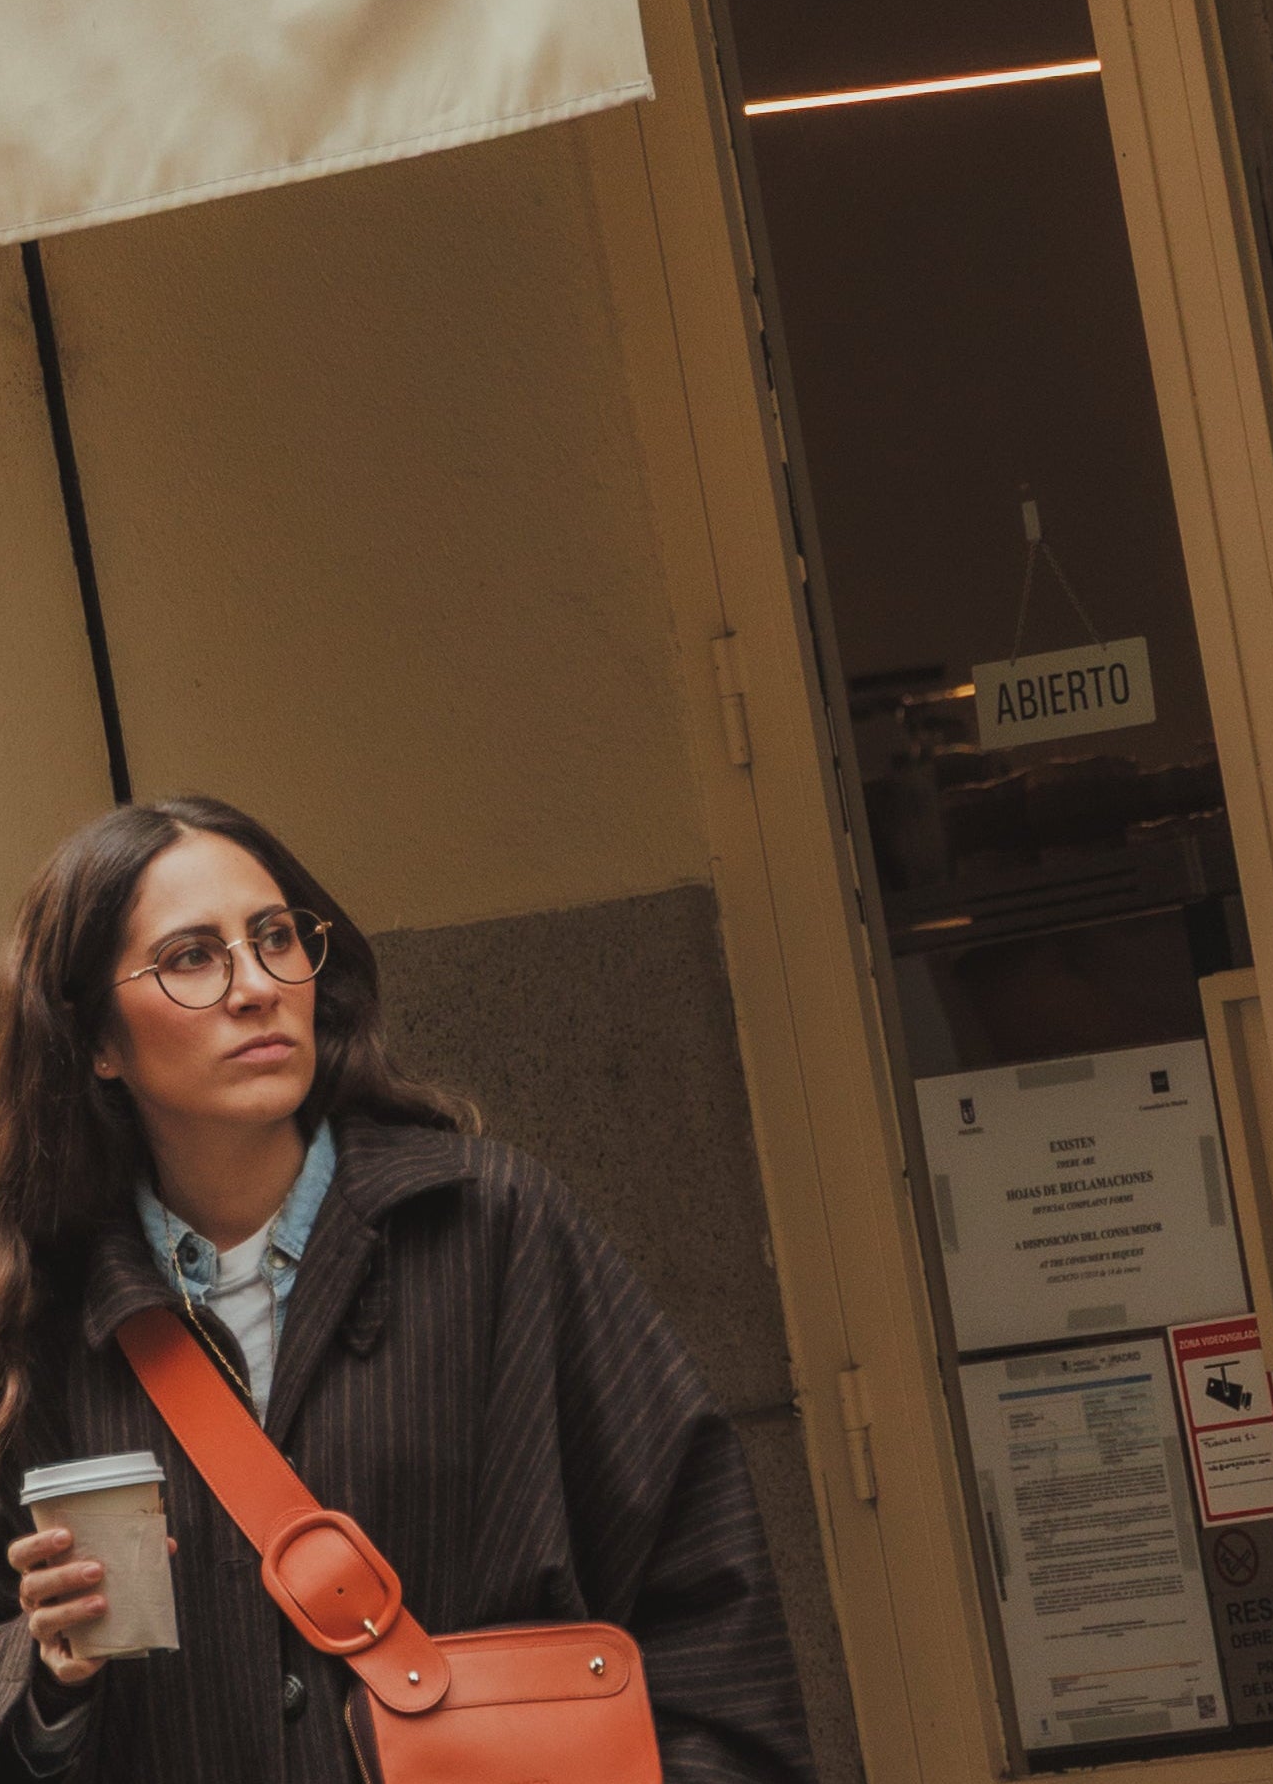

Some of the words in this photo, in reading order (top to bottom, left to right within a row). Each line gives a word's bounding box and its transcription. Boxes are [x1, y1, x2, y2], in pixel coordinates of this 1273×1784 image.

[997, 662, 1130, 725] ABIERTO
[1049, 1136, 1096, 1153] EXISTEN
[1006, 1186, 1042, 1202] HOJAS
[1043, 1183, 1059, 1197] DE
[1059, 1170, 1154, 1195] RECLAMACIONES
[1015, 1242, 1022, 1251] A
[1022, 1231, 1080, 1250] DISPOSICIÓN
[1080, 1231, 1099, 1243] DEL
[1100, 1221, 1163, 1239] CONSUMIDOR
[1178, 1338, 1201, 1350] ZONA
[1242, 1682, 1262, 1698] DE
[1256, 1702, 1266, 1716] A
